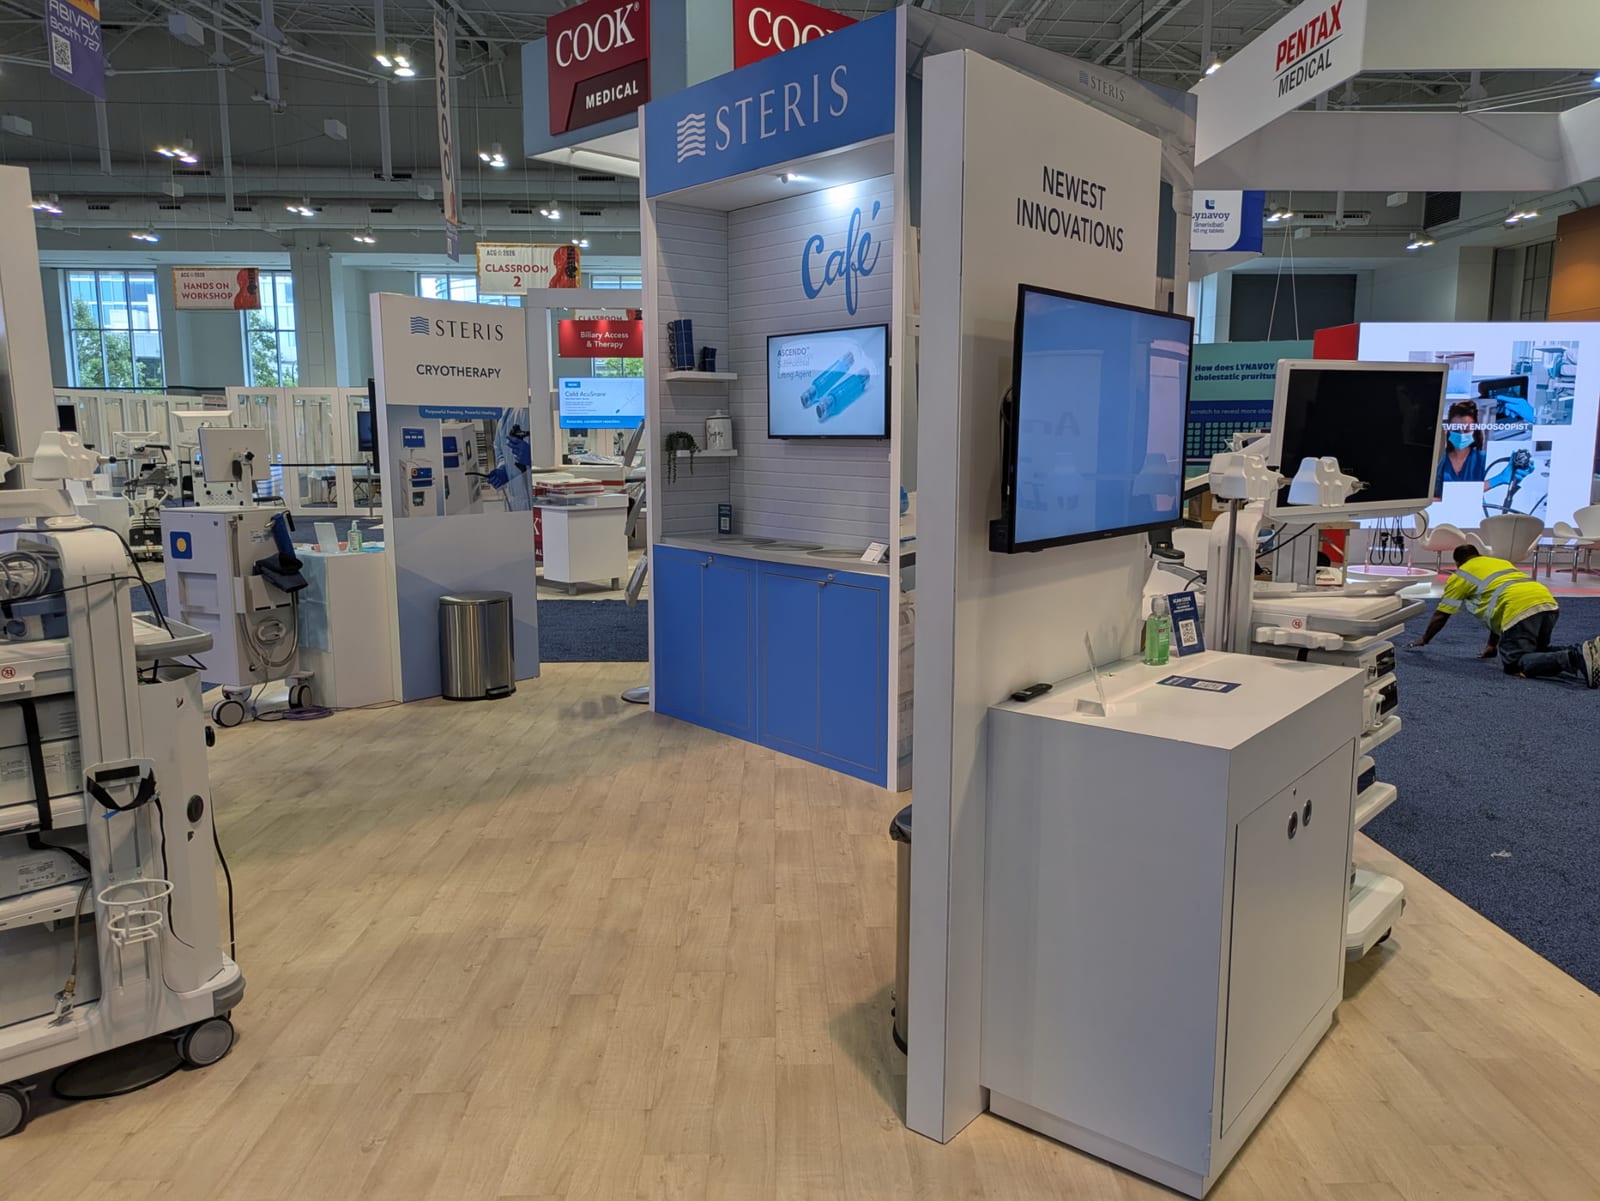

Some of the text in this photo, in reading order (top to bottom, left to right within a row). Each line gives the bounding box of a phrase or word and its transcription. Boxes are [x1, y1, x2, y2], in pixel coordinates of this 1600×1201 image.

[49, 0, 99, 40] ABIVAX
[50, 15, 100, 52] Booth 727
[1275, 0, 1343, 72] PENTAX
[1278, 48, 1332, 98] MEDICAL
[585, 79, 639, 110] MEDICAL
[1090, 75, 1126, 102] STERIS
[438, 39, 451, 181] 2800
[715, 64, 848, 151] STERIS
[1042, 165, 1106, 211] NEWEST
[1016, 197, 1124, 252] INNOVATIONS
[1192, 212, 1230, 221] ynavoy
[484, 264, 549, 273] CLASSROOM
[802, 200, 881, 316] Café
[183, 282, 230, 290] HANDS ON
[513, 276, 522, 288] 2
[181, 292, 233, 300] WORKSHOP
[435, 319, 504, 341] STERIS
[580, 331, 629, 340] Biliary Access
[594, 341, 623, 349] Therapy
[416, 364, 501, 378] CRYOTHERAPY
[1194, 372, 1239, 381] cholestatic
[1195, 362, 1275, 372] How does LYNAVOY
[1469, 423, 1529, 431] ENDOSCOPIST
